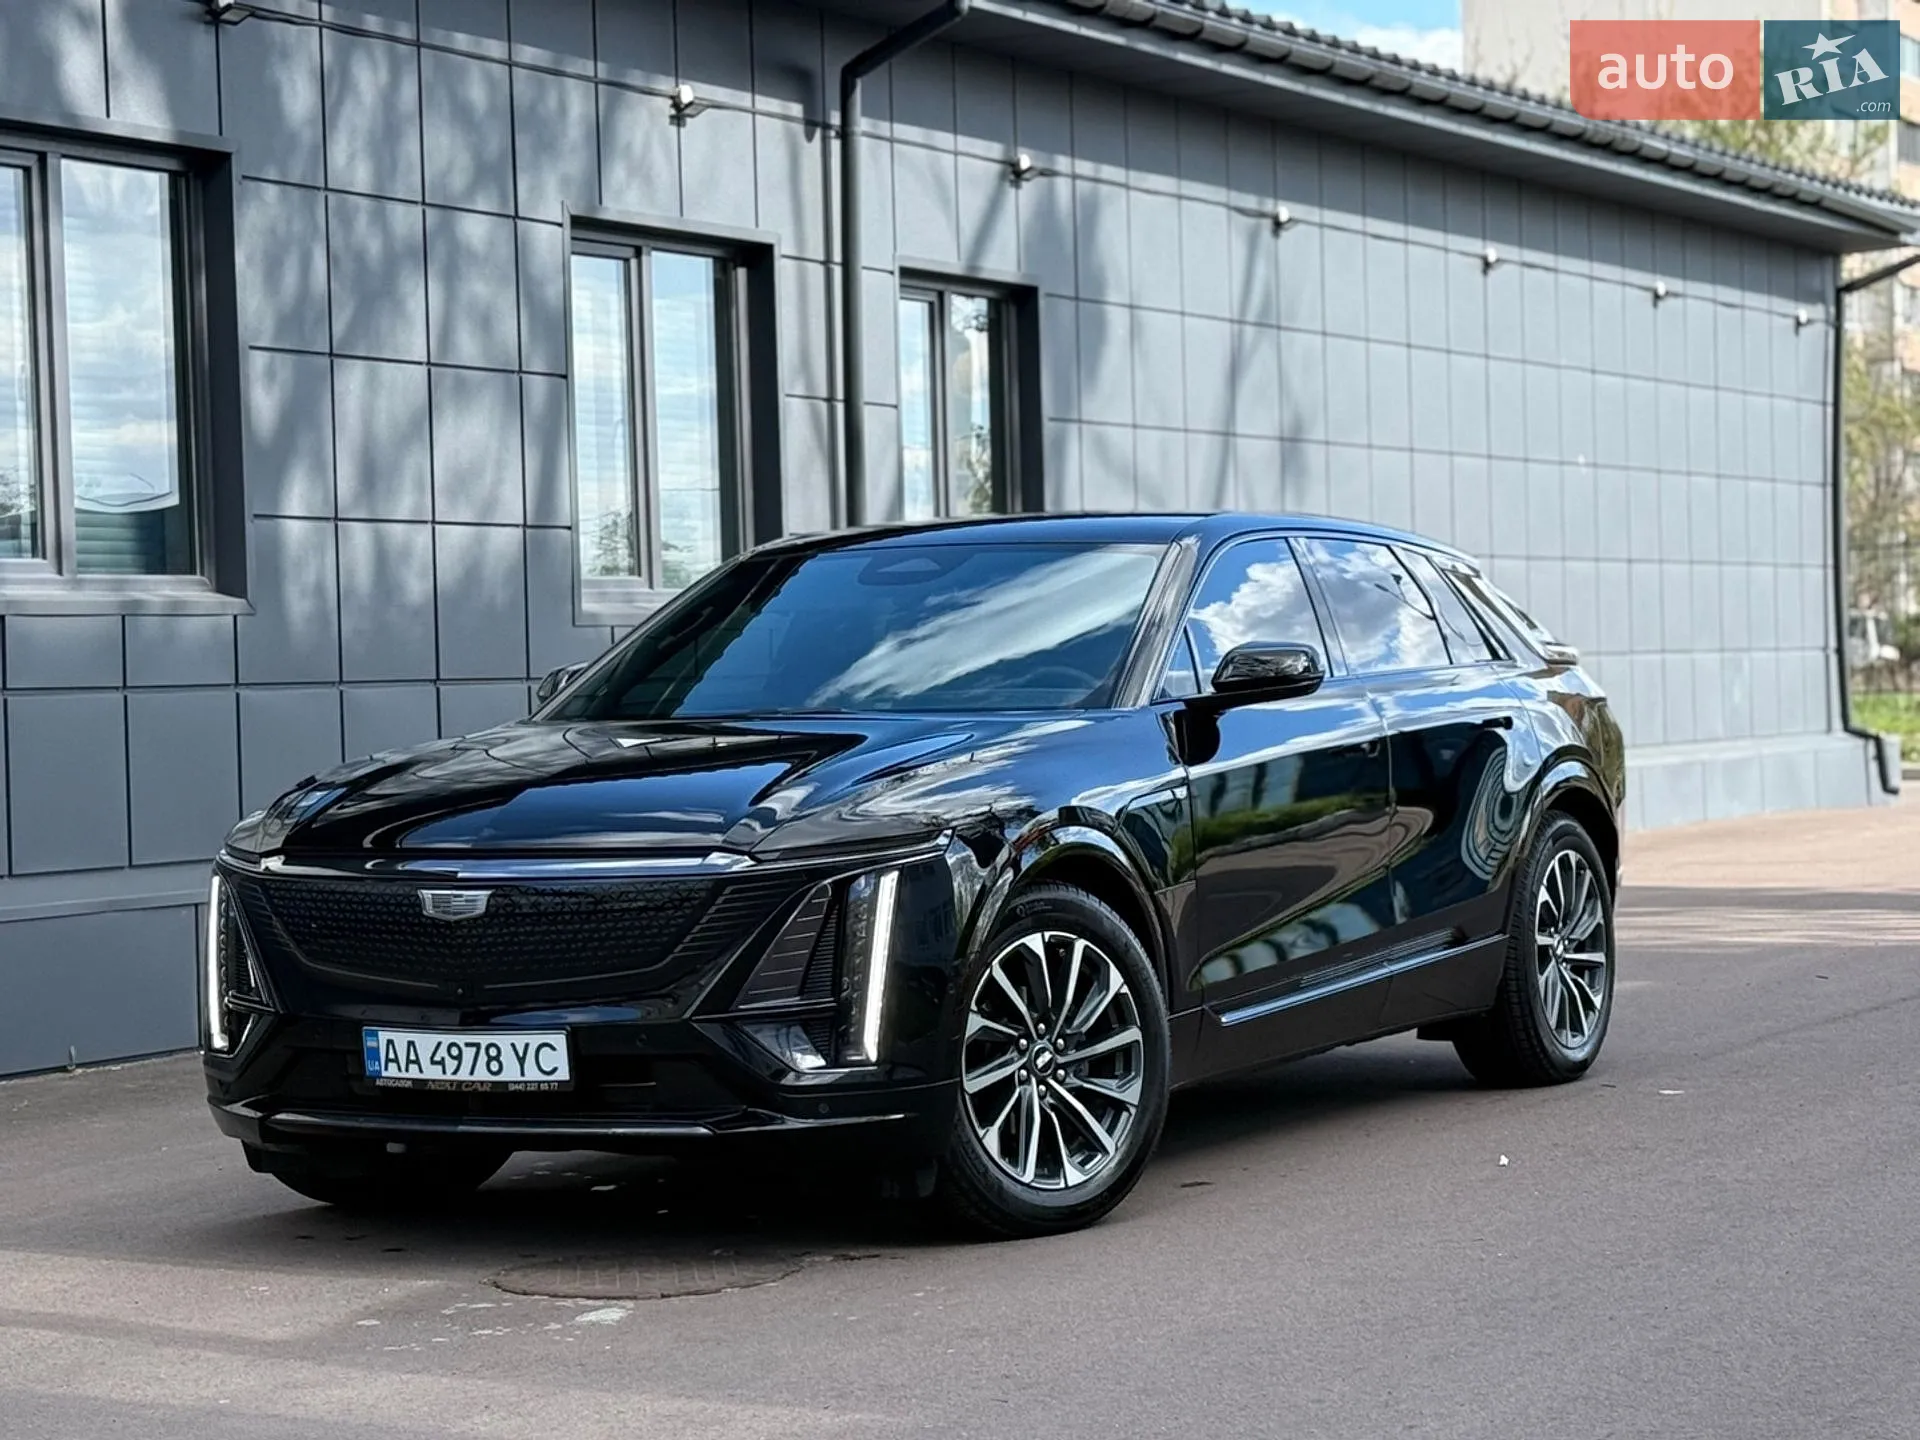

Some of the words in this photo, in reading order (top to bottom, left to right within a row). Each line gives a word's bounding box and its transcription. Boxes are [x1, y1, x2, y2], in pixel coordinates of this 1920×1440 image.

[367, 1063, 380, 1071] UA
[383, 1038, 424, 1074] AA
[429, 1041, 504, 1077] 4978
[510, 1041, 559, 1077] YC
